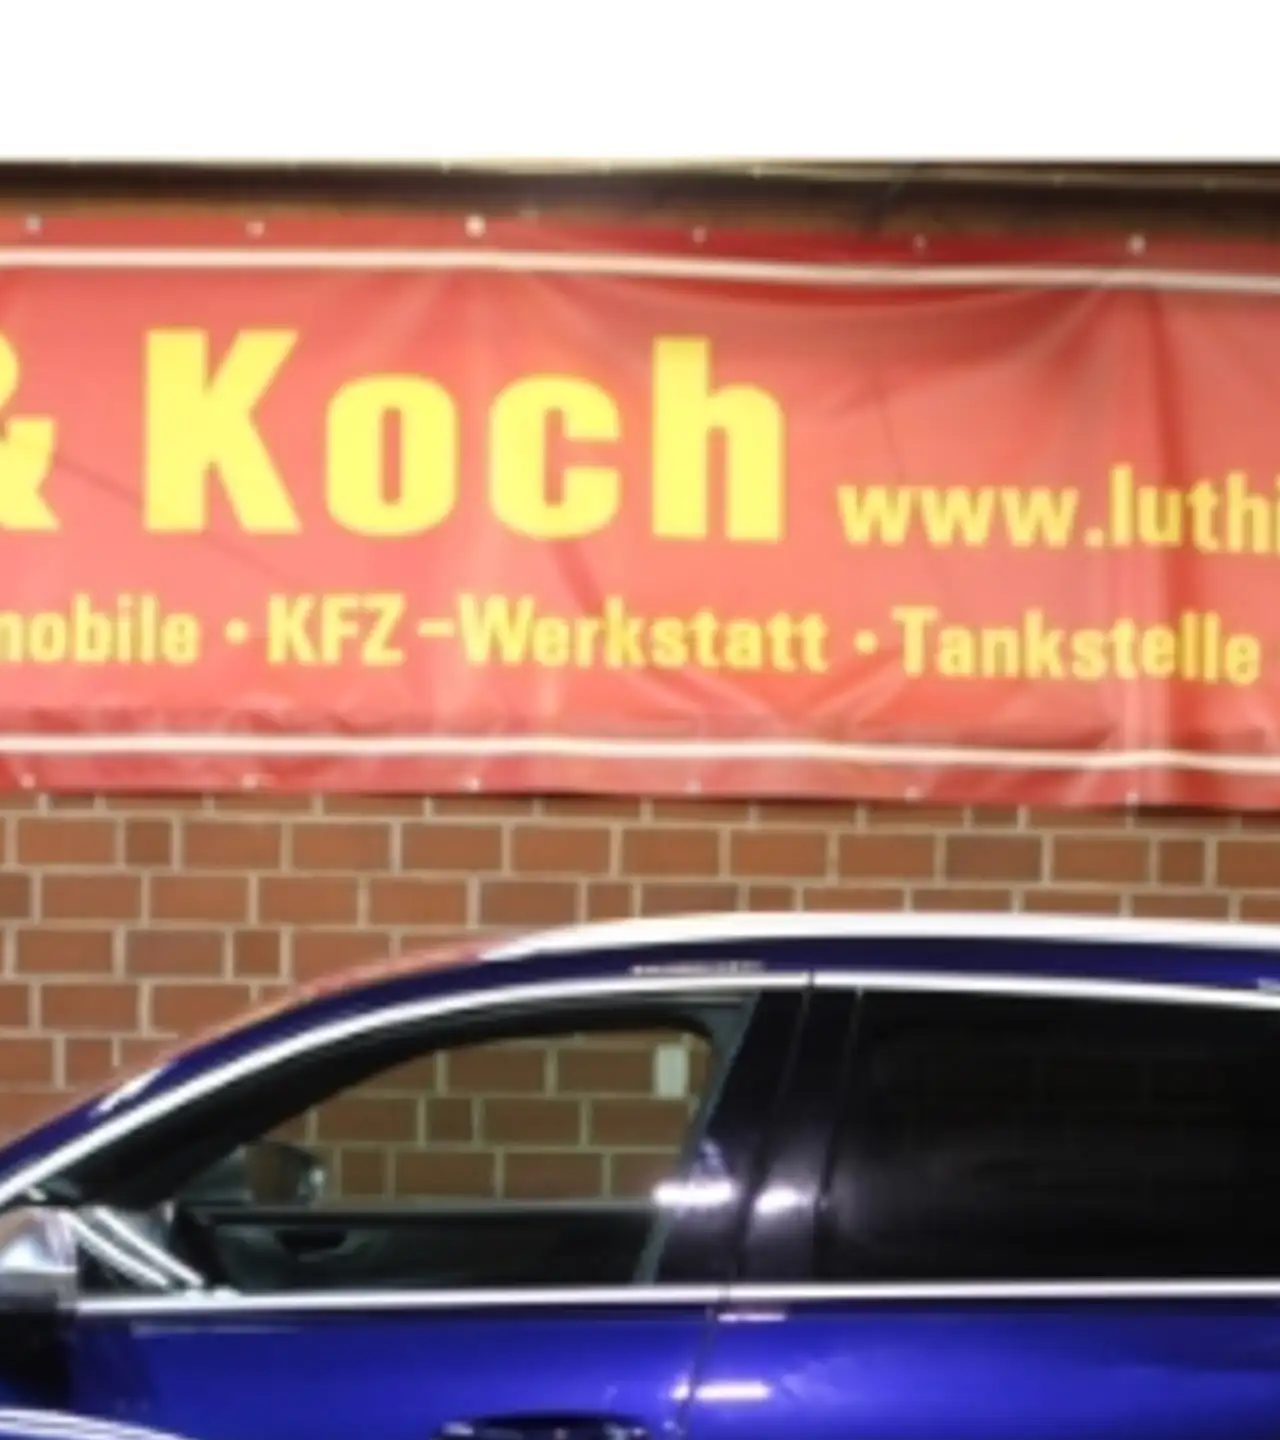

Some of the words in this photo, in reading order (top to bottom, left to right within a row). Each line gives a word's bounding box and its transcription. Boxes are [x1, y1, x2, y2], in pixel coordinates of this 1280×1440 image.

[139, 323, 788, 546] Koch
[265, 593, 830, 674] KFZ-Werkstatt
[892, 604, 1263, 686] Tankstelle
